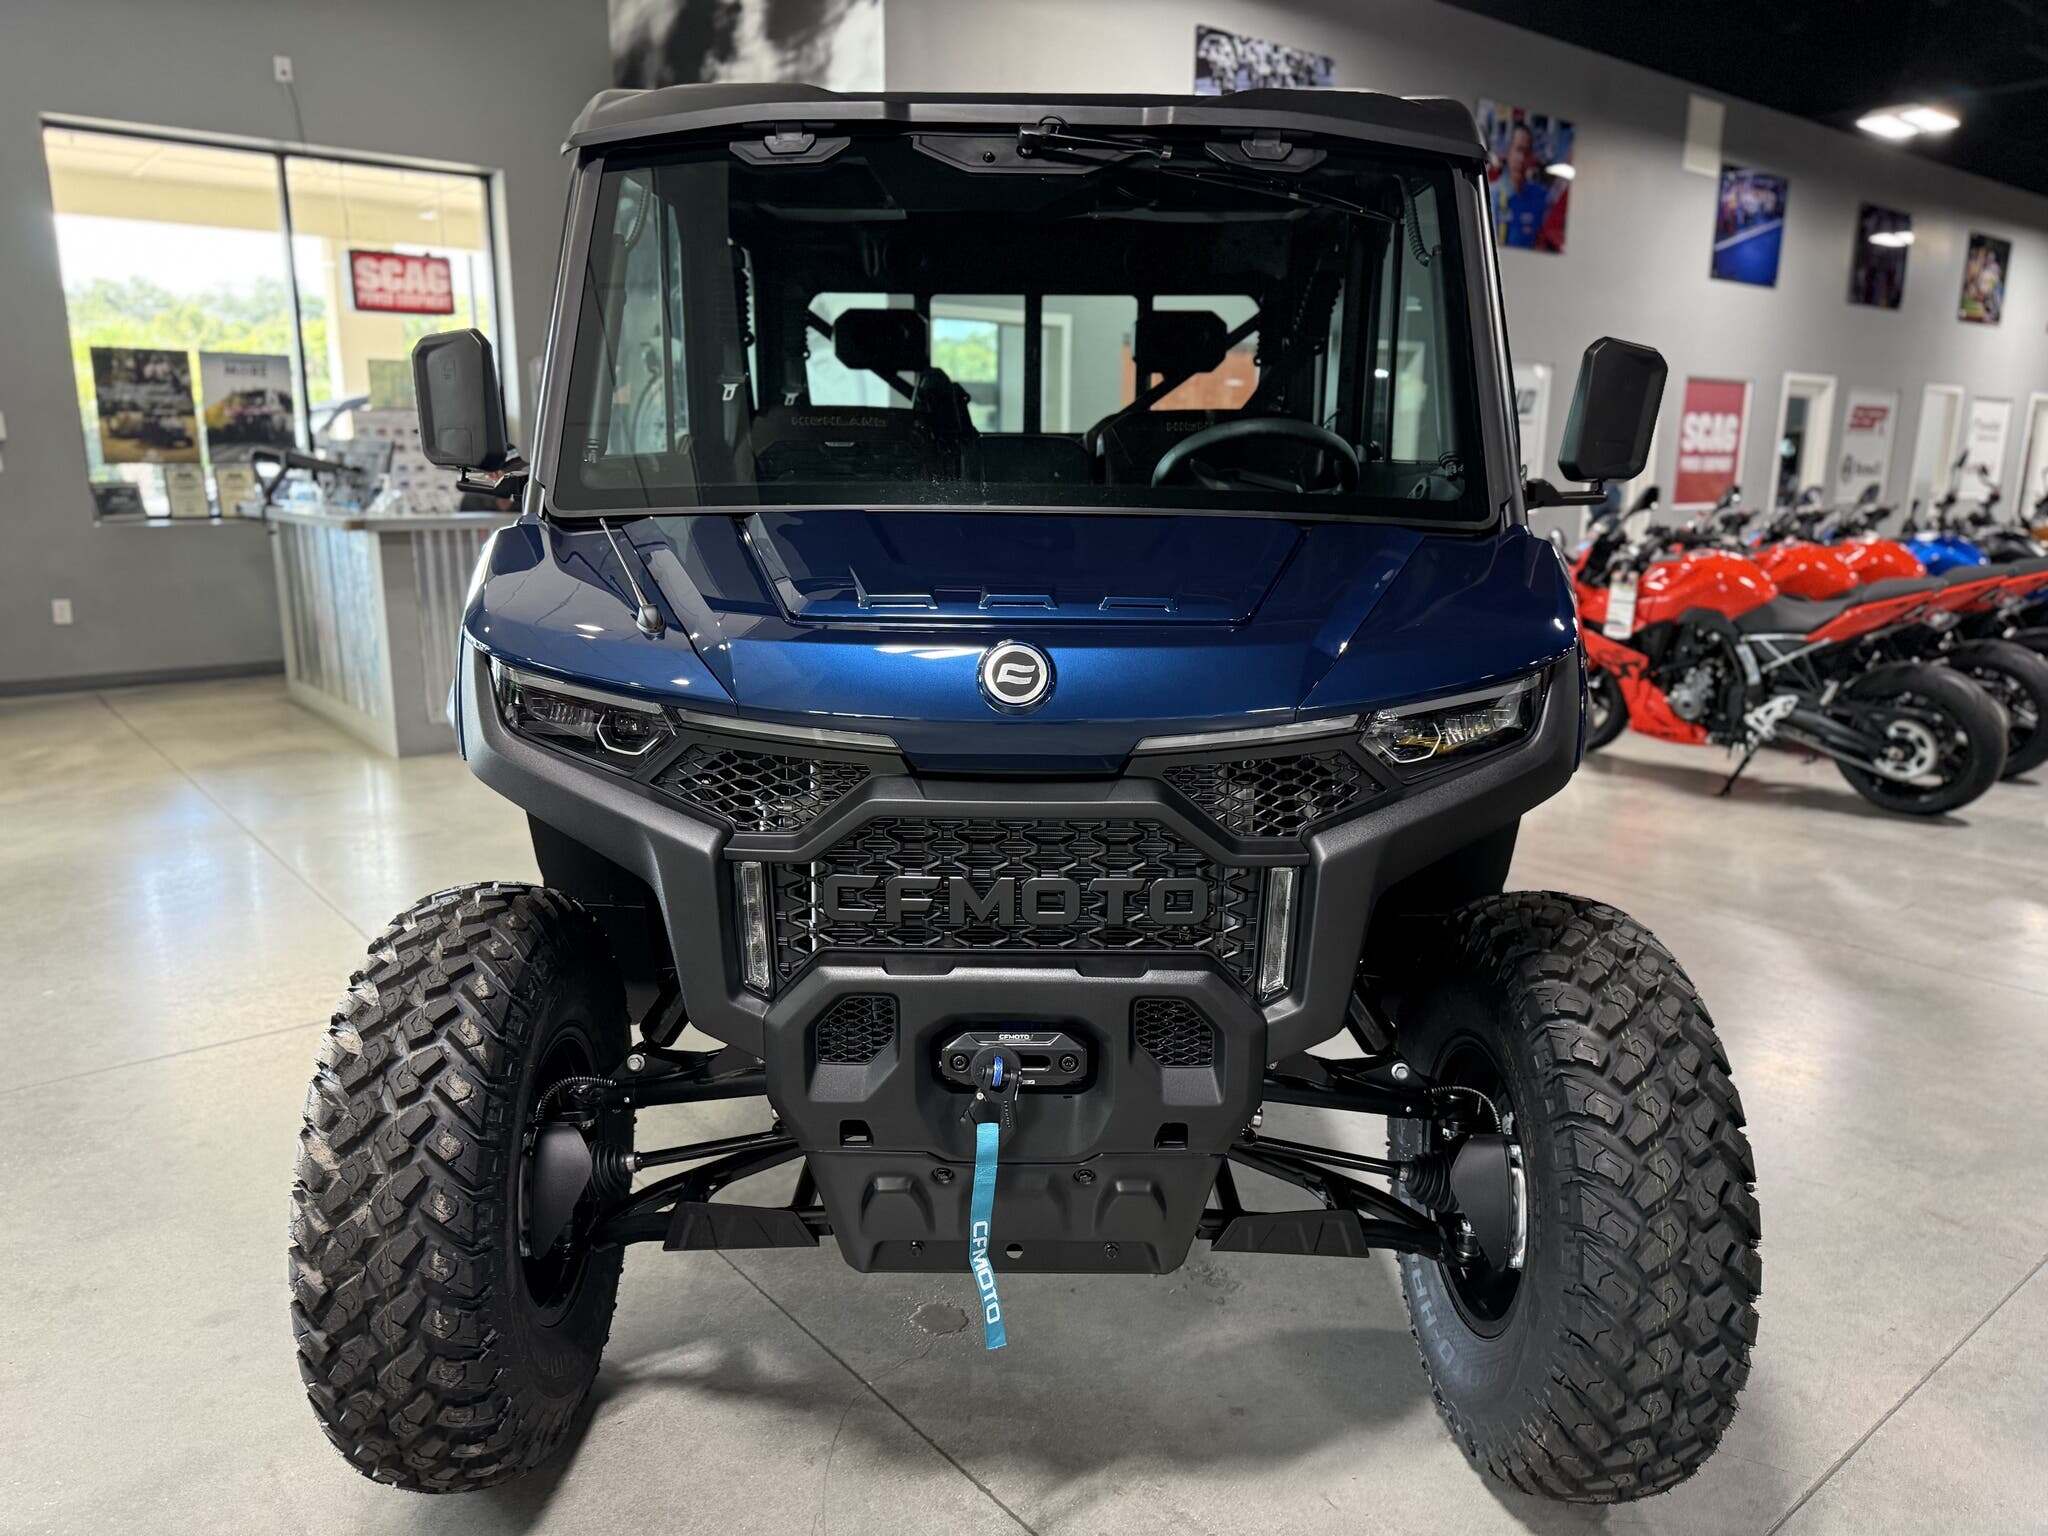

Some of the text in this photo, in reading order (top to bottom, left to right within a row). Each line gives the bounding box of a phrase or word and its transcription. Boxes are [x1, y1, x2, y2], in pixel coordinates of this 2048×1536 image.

[354, 256, 450, 293] SCAG
[1682, 412, 1739, 450] SCAG
[823, 873, 1209, 926] CFMOTO
[998, 1033, 1030, 1041] CFMOTO
[973, 1221, 1000, 1324] CFMOTO
